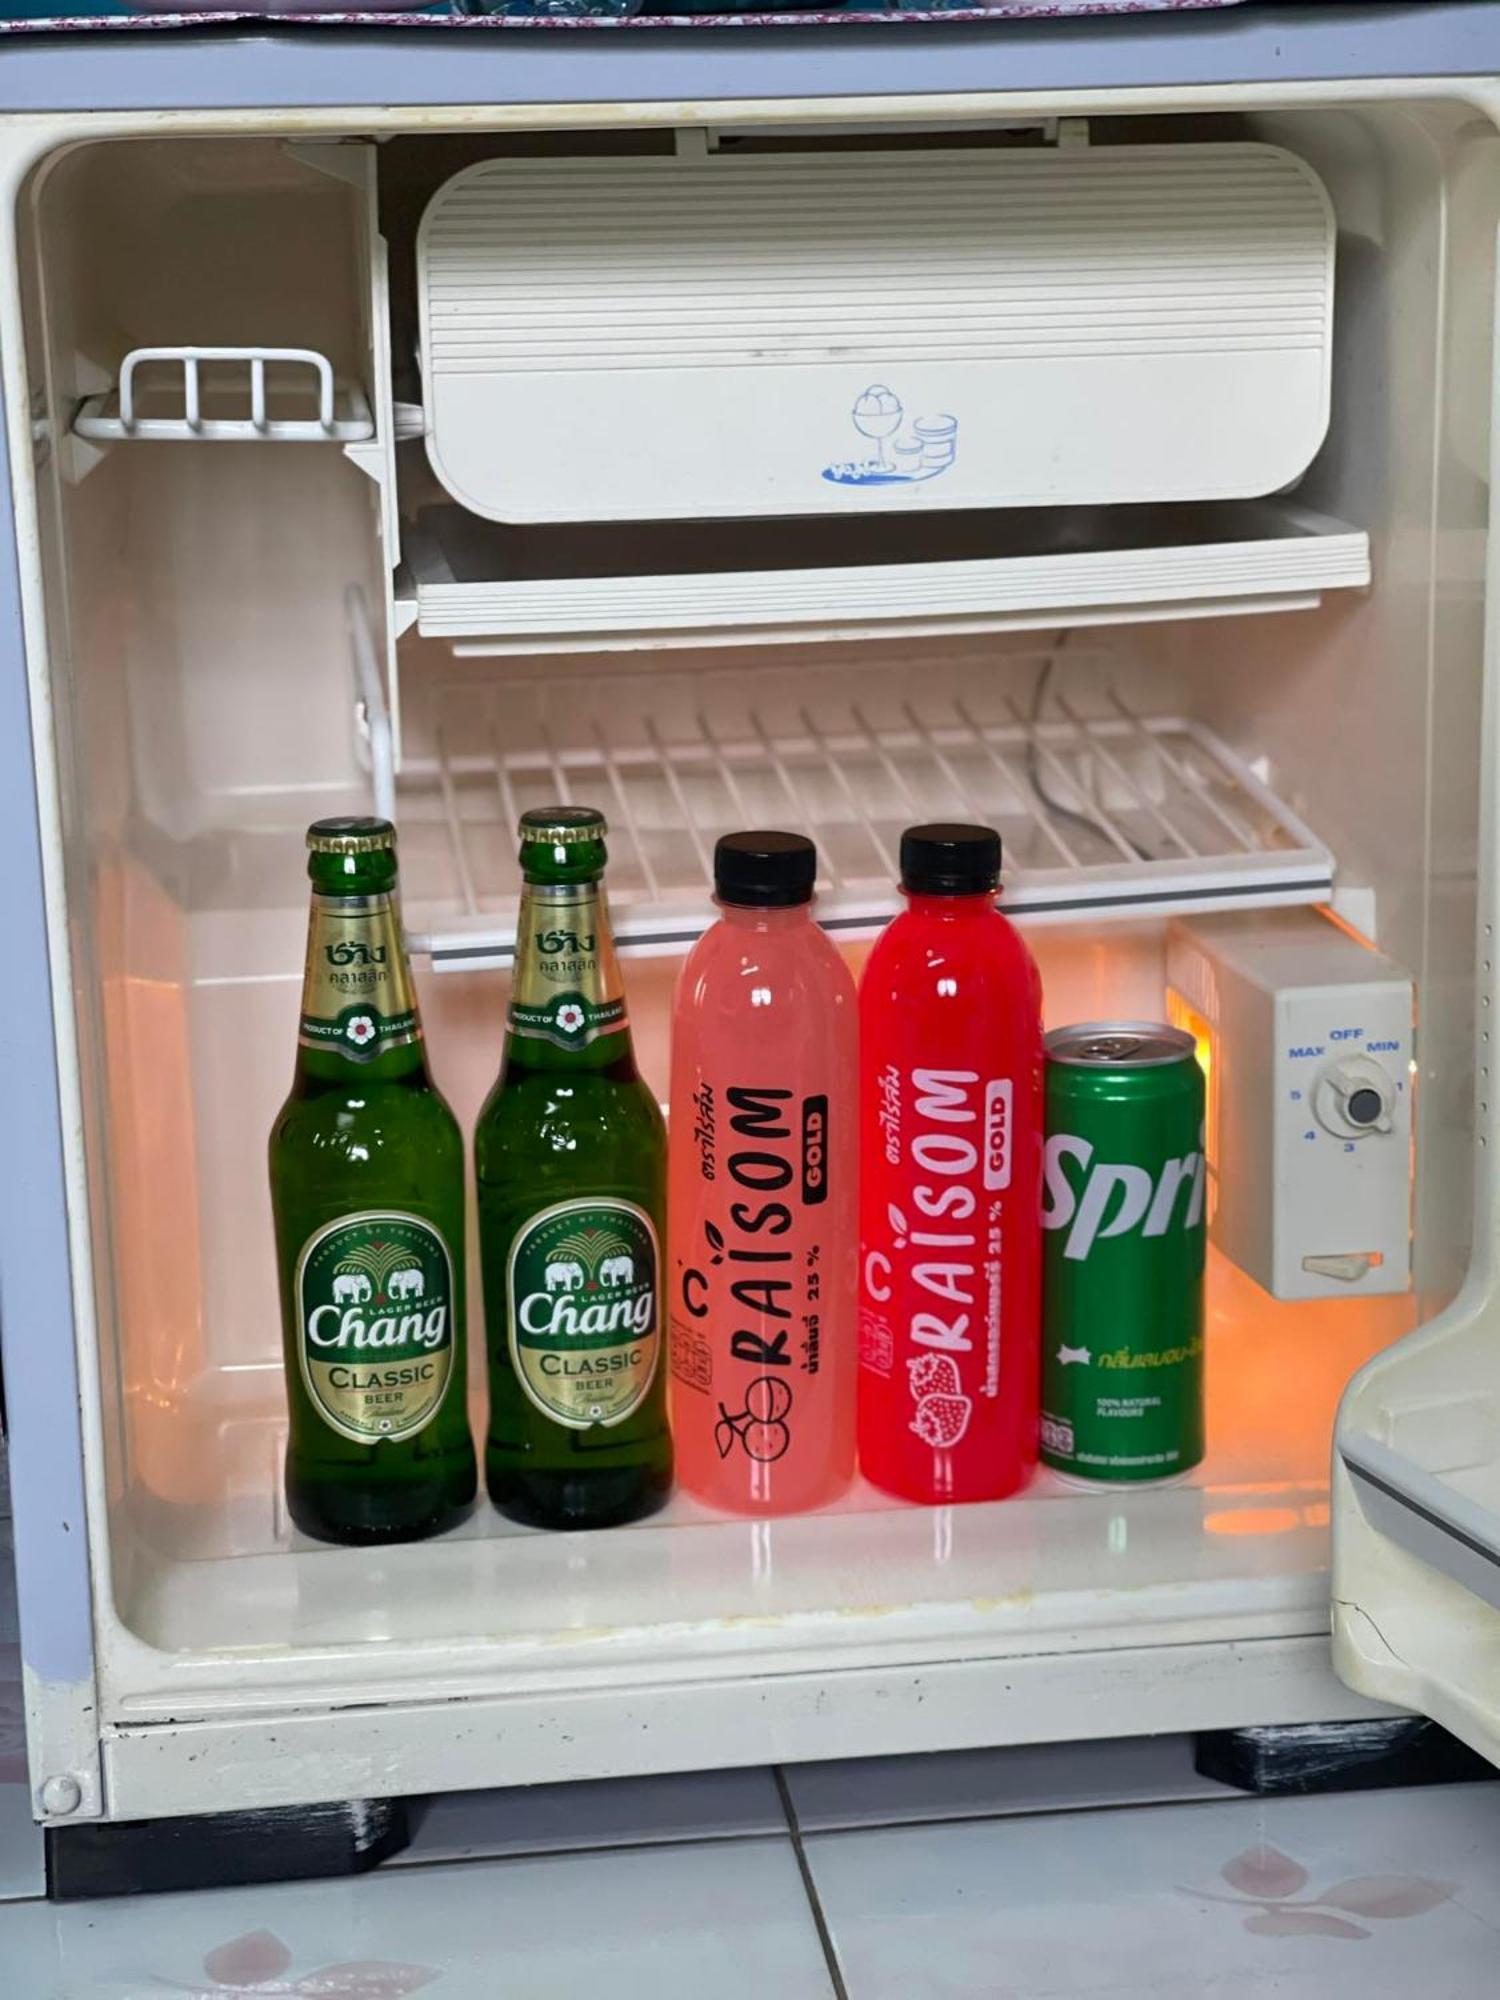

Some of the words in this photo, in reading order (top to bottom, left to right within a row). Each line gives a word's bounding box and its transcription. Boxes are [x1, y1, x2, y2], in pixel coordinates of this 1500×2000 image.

[325, 941, 386, 966] ช้าง
[536, 930, 595, 954] ช้าง
[1329, 1028, 1364, 1041] OFF
[1366, 1040, 1400, 1052] MIN
[1289, 1046, 1325, 1058] MAX
[1396, 1081, 1404, 1091] 1
[989, 1096, 1006, 1172] GOLD
[1304, 1130, 1316, 1140] 4
[806, 1111, 823, 1188] GOLD
[910, 1067, 980, 1352] RAISOM
[988, 1200, 1003, 1222] %
[726, 1086, 794, 1366] RAISOM
[988, 1227, 1002, 1255] 25
[807, 1244, 820, 1267] %
[580, 1292, 622, 1303] LAGER
[807, 1272, 820, 1301] 25
[368, 1304, 412, 1316] LAGER
[519, 1292, 653, 1335] Chang
[308, 1304, 447, 1349] Chang
[575, 1378, 614, 1391] BEER
[364, 1392, 404, 1405] BEER
